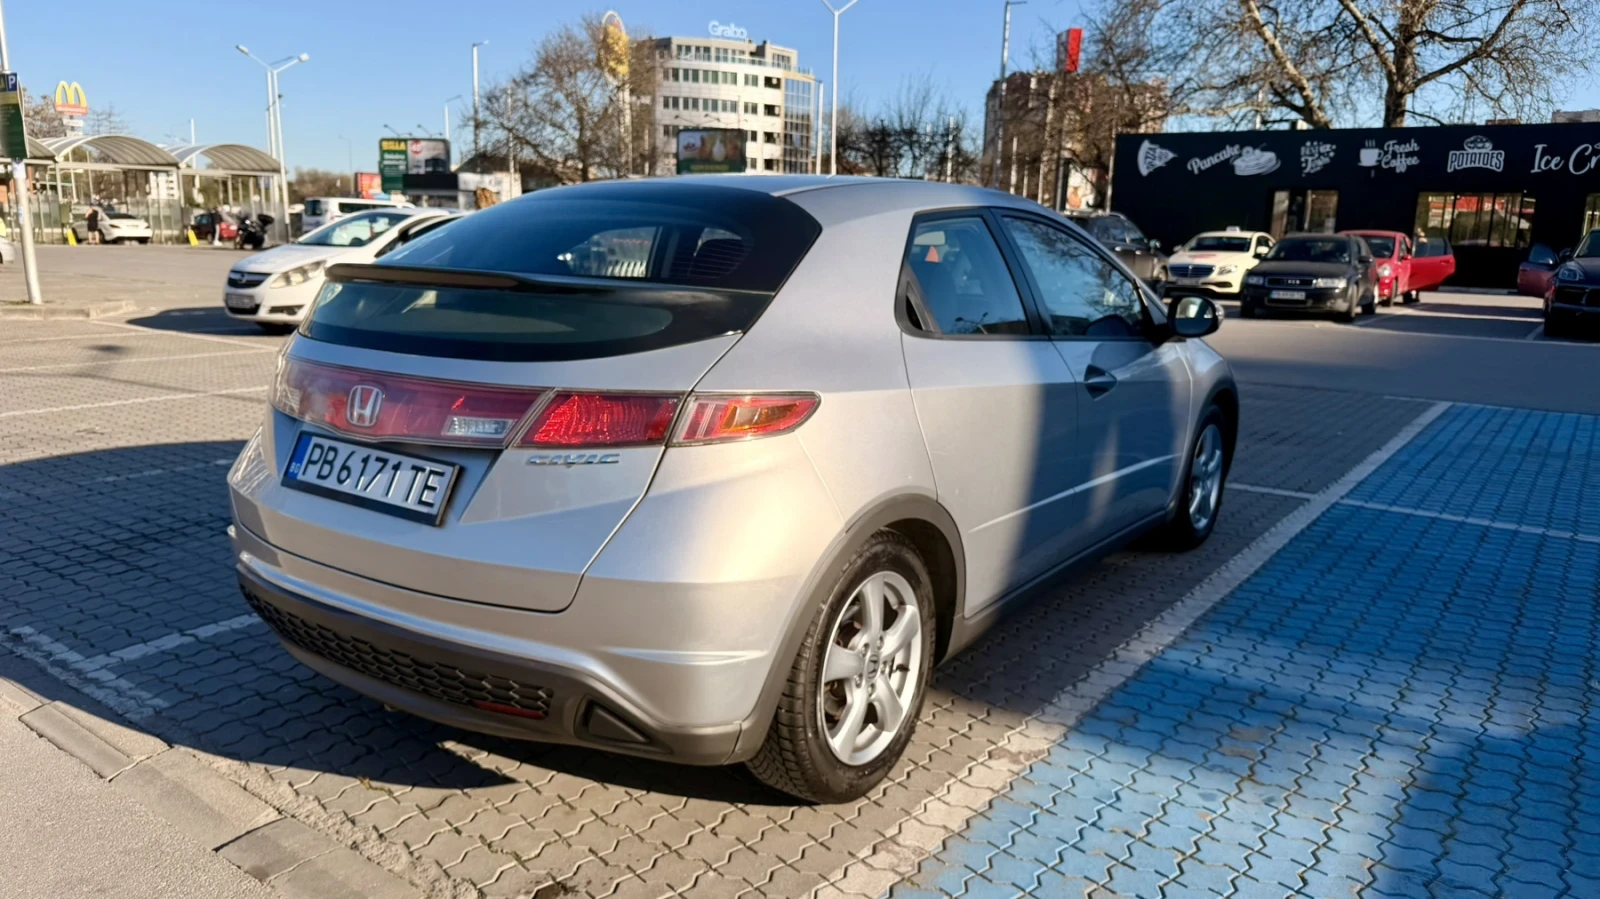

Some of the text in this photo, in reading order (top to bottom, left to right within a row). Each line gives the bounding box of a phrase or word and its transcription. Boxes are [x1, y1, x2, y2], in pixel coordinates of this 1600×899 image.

[708, 20, 748, 39] Grabo
[8, 75, 16, 89] P
[1384, 138, 1420, 155] Fresh
[1187, 144, 1241, 175] Pancake
[1381, 154, 1420, 173] Coffee
[1447, 150, 1505, 172] POTATOES
[1530, 144, 1565, 173] Ice
[527, 453, 620, 465] CIVIC
